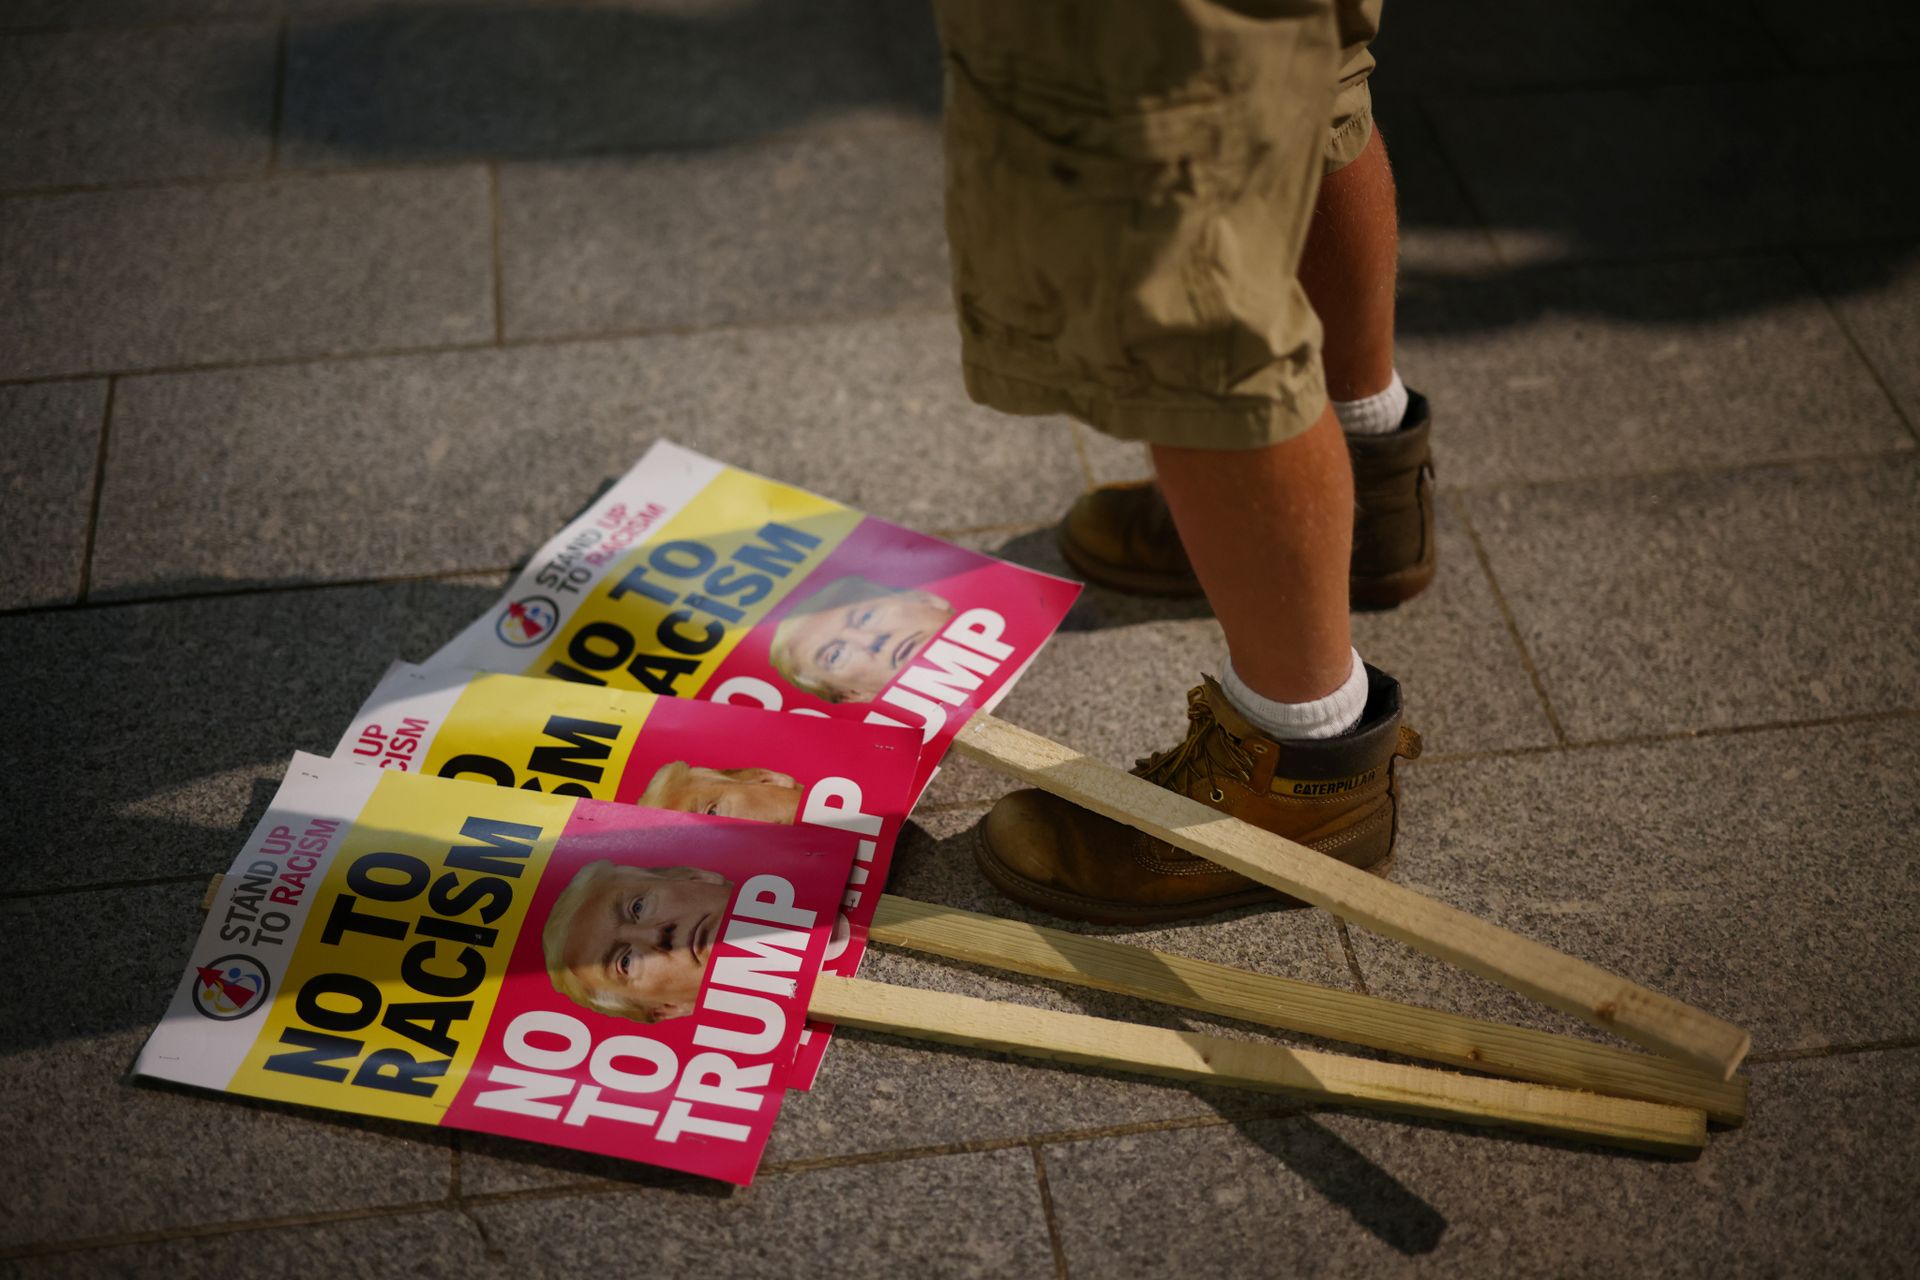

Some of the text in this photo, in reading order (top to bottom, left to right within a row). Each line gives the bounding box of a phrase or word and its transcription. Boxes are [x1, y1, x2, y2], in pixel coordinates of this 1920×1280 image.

[535, 502, 627, 588] STAND UP
[555, 503, 667, 594] TO RACISM
[608, 539, 717, 606] TO
[626, 522, 823, 697] ACISM
[863, 608, 1015, 745] UMP
[353, 724, 388, 757] UP
[1293, 768, 1376, 796] CATERPILLAR
[220, 825, 297, 943] STAND UP
[252, 818, 340, 946] TO RACISM
[263, 852, 431, 1084] NO TO
[351, 816, 543, 1098] RACISM
[655, 874, 818, 1143] TRUMP
[473, 1010, 592, 1120] NO
[563, 1035, 679, 1126] TO
